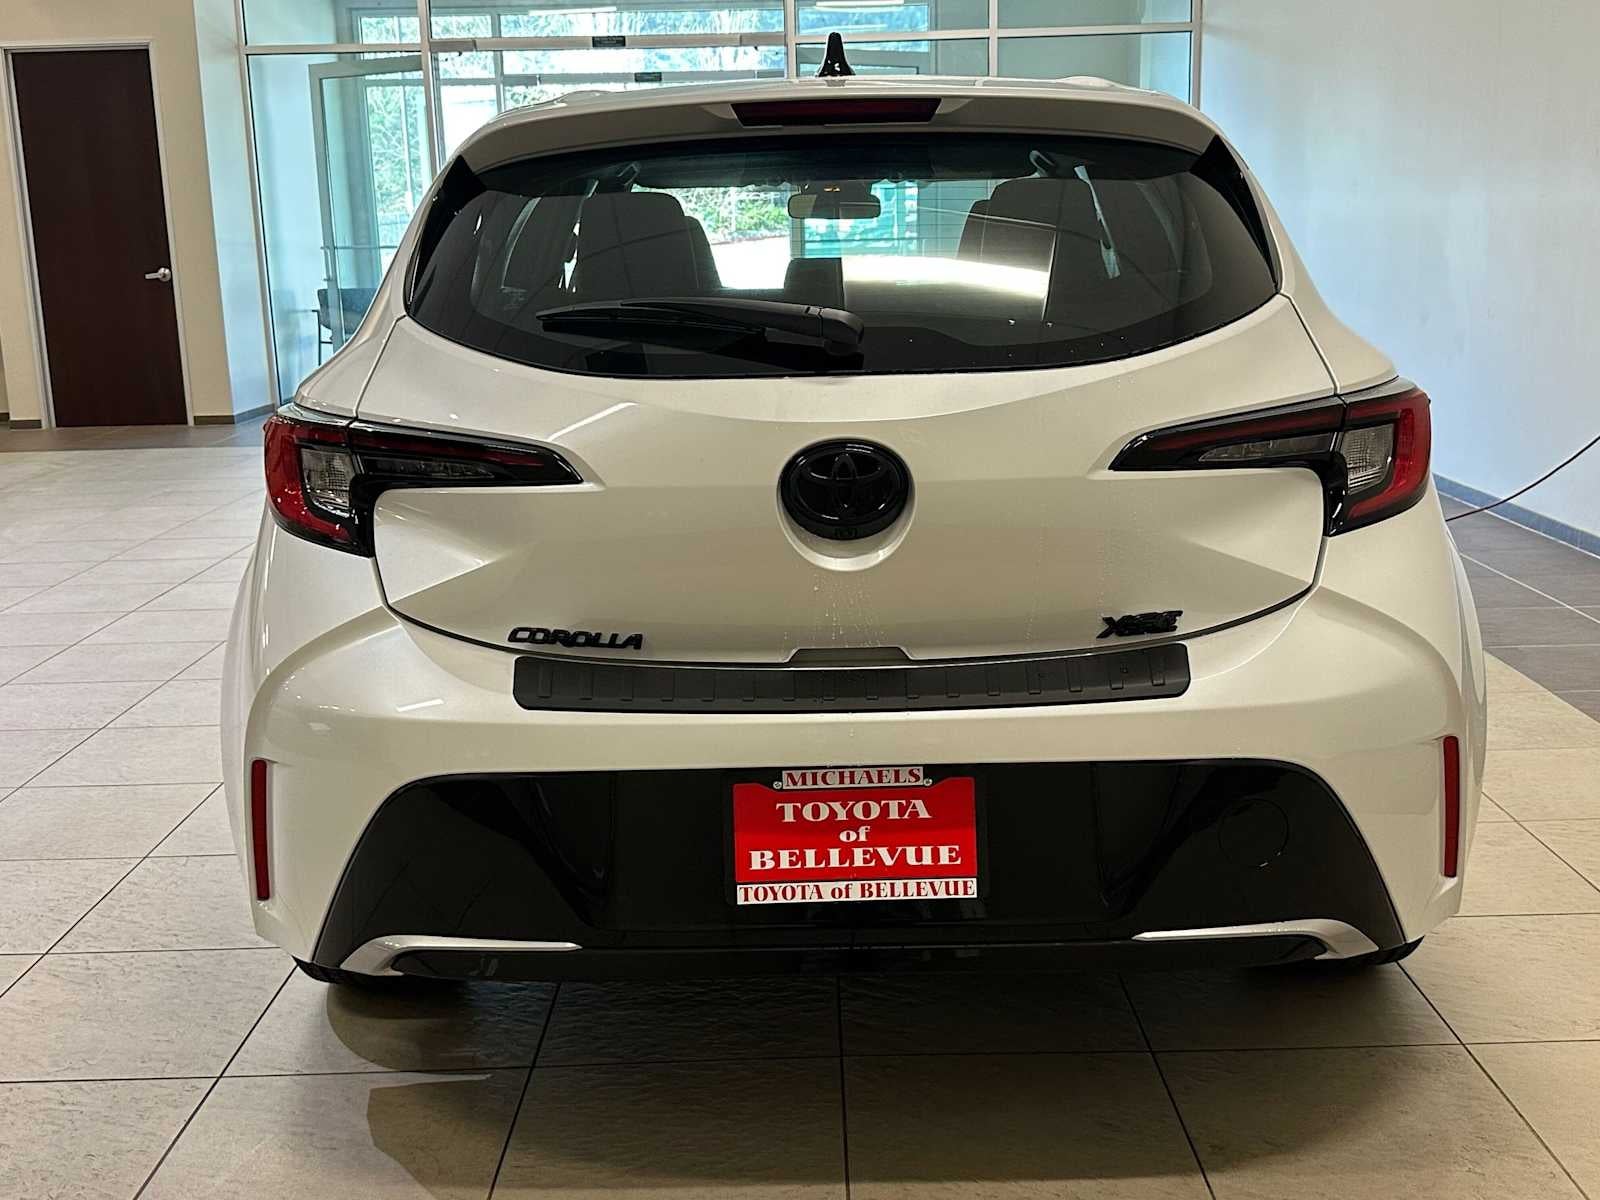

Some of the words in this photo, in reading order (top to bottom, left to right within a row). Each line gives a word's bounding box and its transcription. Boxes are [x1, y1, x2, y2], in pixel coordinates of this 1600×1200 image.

[508, 627, 643, 650] COROLLA
[785, 768, 921, 787] MICHAELS
[776, 800, 932, 822] TOYOTA
[839, 826, 871, 842] of
[748, 845, 962, 870] BELLEVUE
[739, 884, 823, 902] TOYOTA
[831, 883, 853, 900] of
[860, 880, 975, 898] BELLEVUE
